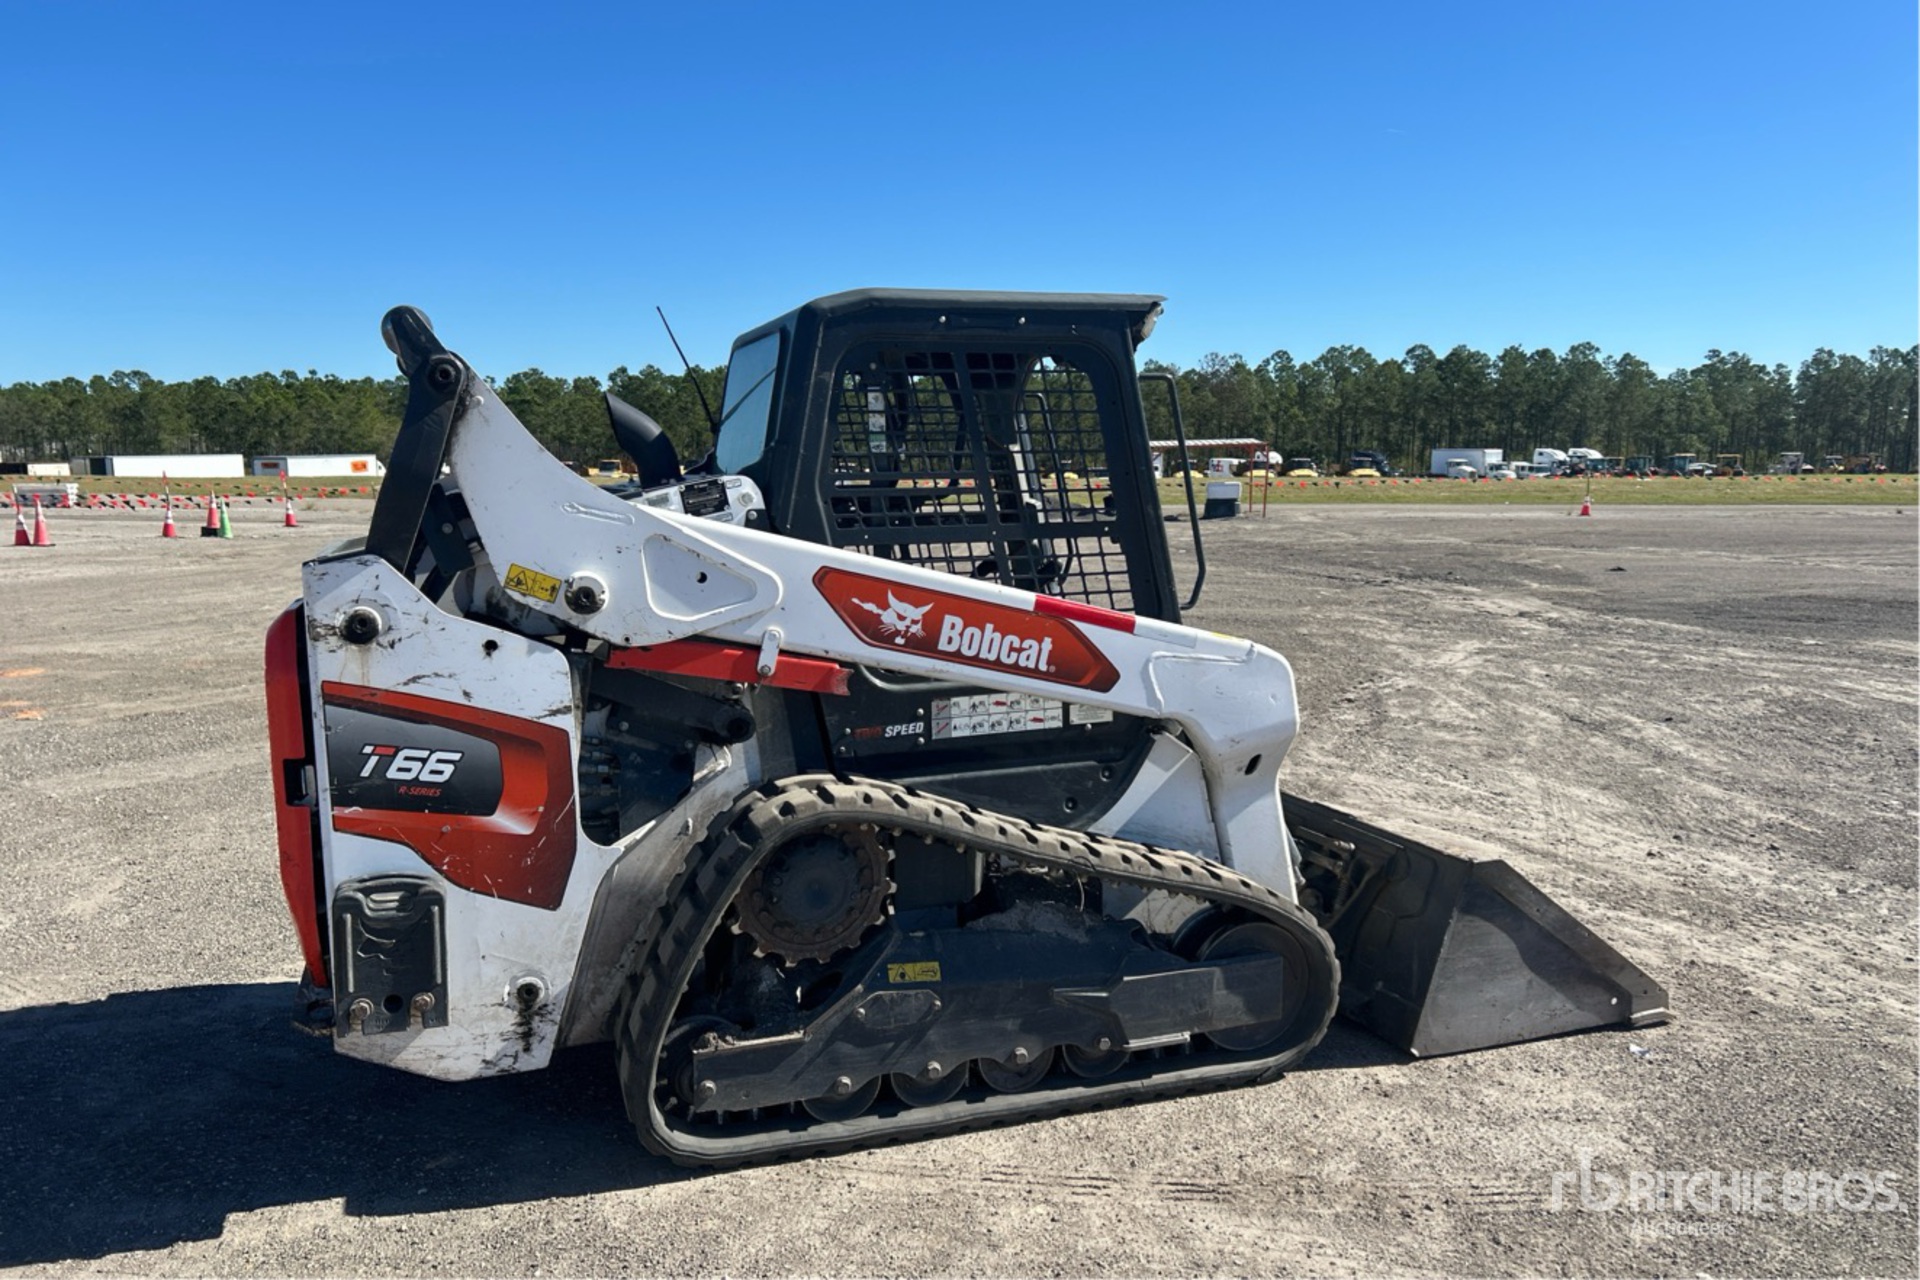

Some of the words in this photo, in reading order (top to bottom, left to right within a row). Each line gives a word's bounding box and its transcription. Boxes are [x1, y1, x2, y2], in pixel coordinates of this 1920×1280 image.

[937, 614, 1053, 672] Bobcat
[884, 722, 925, 738] SPEED
[360, 745, 463, 783] T66
